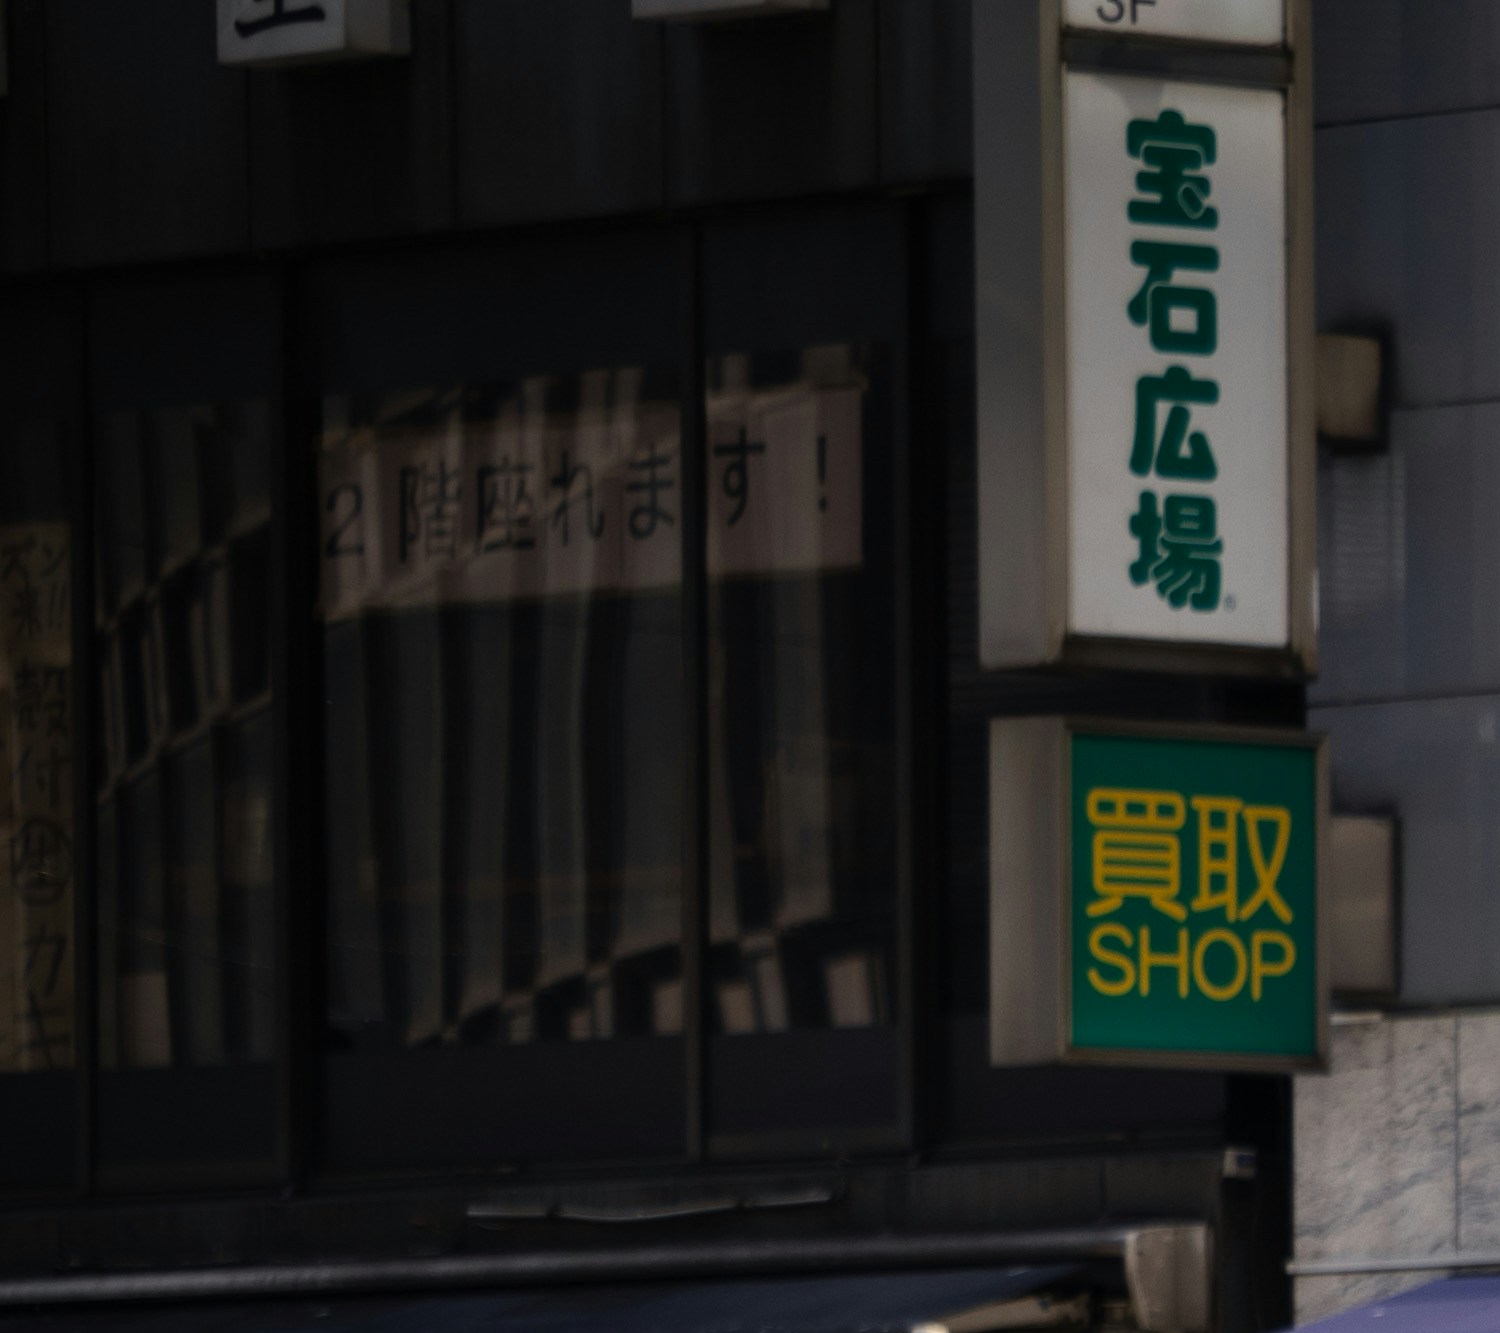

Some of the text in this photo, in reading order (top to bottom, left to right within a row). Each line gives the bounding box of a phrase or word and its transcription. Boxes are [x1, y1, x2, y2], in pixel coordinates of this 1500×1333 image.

[1126, 108, 1223, 613] 宝石広場
[1085, 786, 1293, 923] 買取
[1087, 923, 1297, 1002] SHOP
